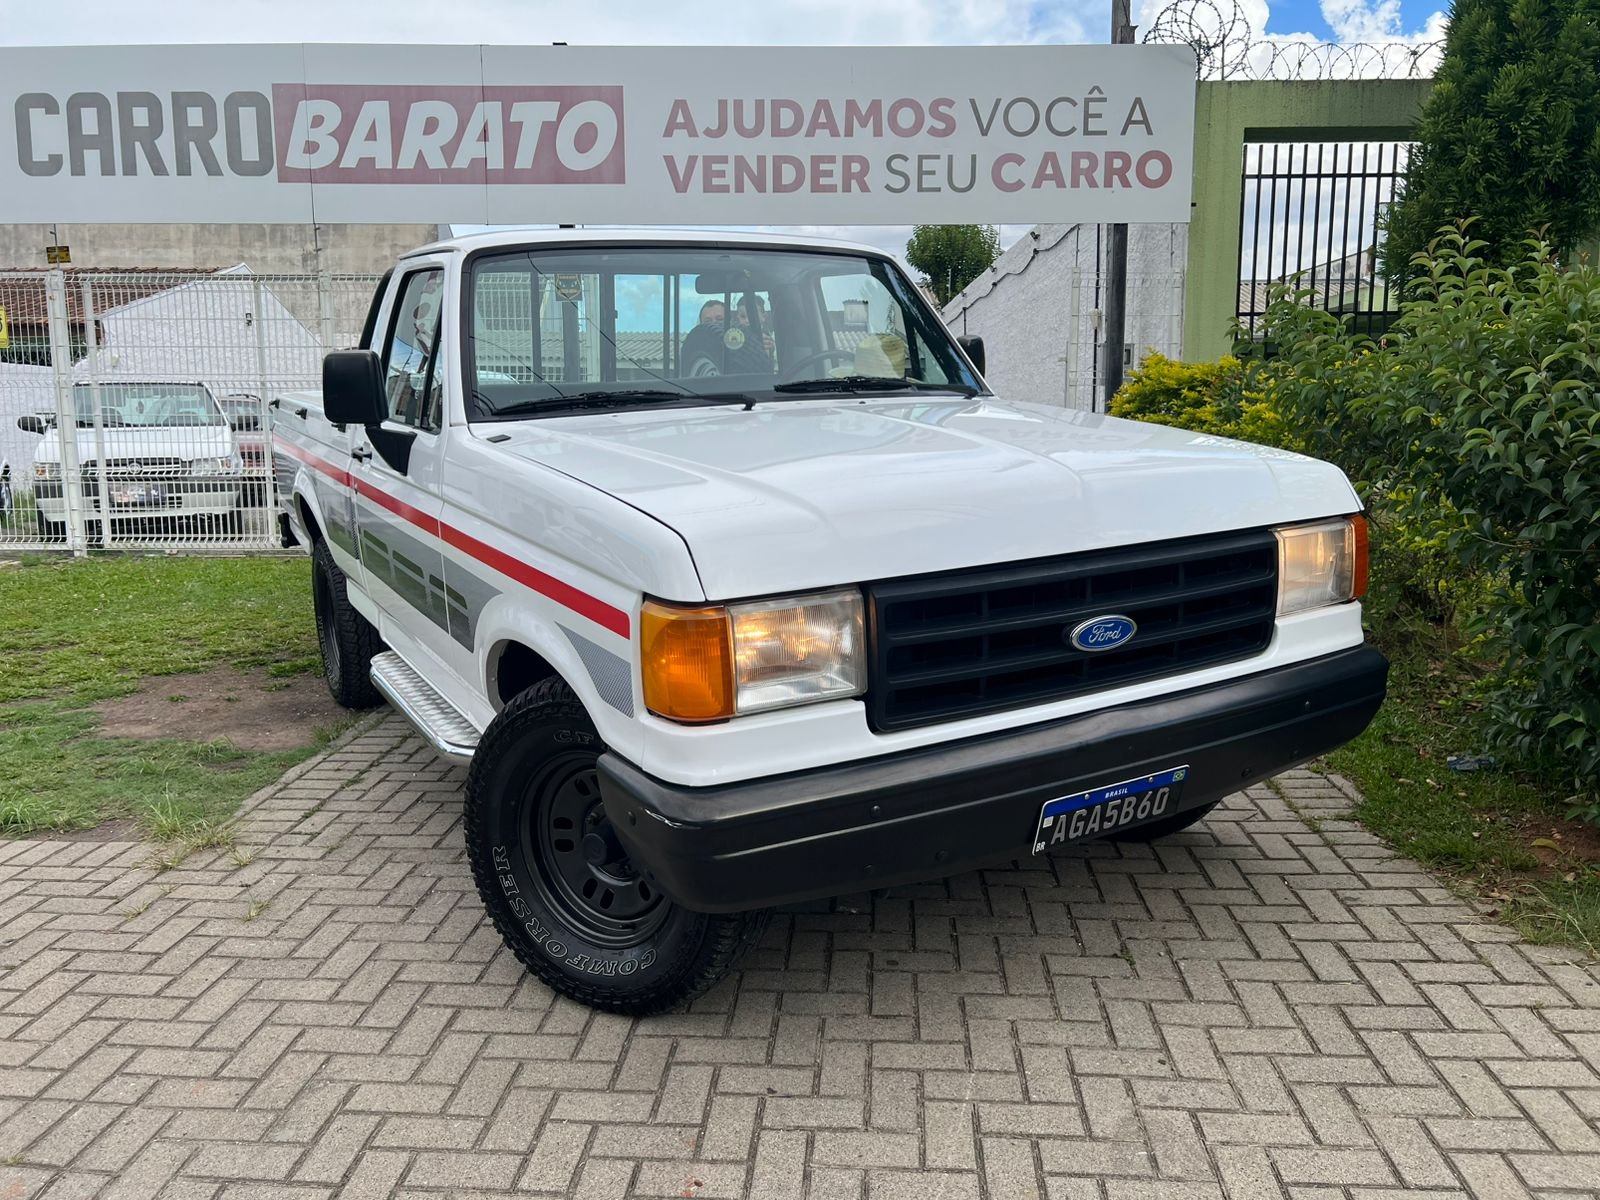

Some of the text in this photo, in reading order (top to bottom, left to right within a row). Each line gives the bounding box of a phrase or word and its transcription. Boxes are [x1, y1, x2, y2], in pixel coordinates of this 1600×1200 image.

[14, 91, 619, 177] CARRO BARATO
[662, 86, 1154, 138] AJUDAMOS VOCÊ A
[663, 150, 1173, 193] VENDER SEU CARRO
[1088, 622, 1122, 643] Ford
[1050, 787, 1170, 845] AGA5B60
[1105, 787, 1129, 799] BRASIL
[1036, 841, 1046, 852] BR
[492, 845, 657, 976] COMFORSER
